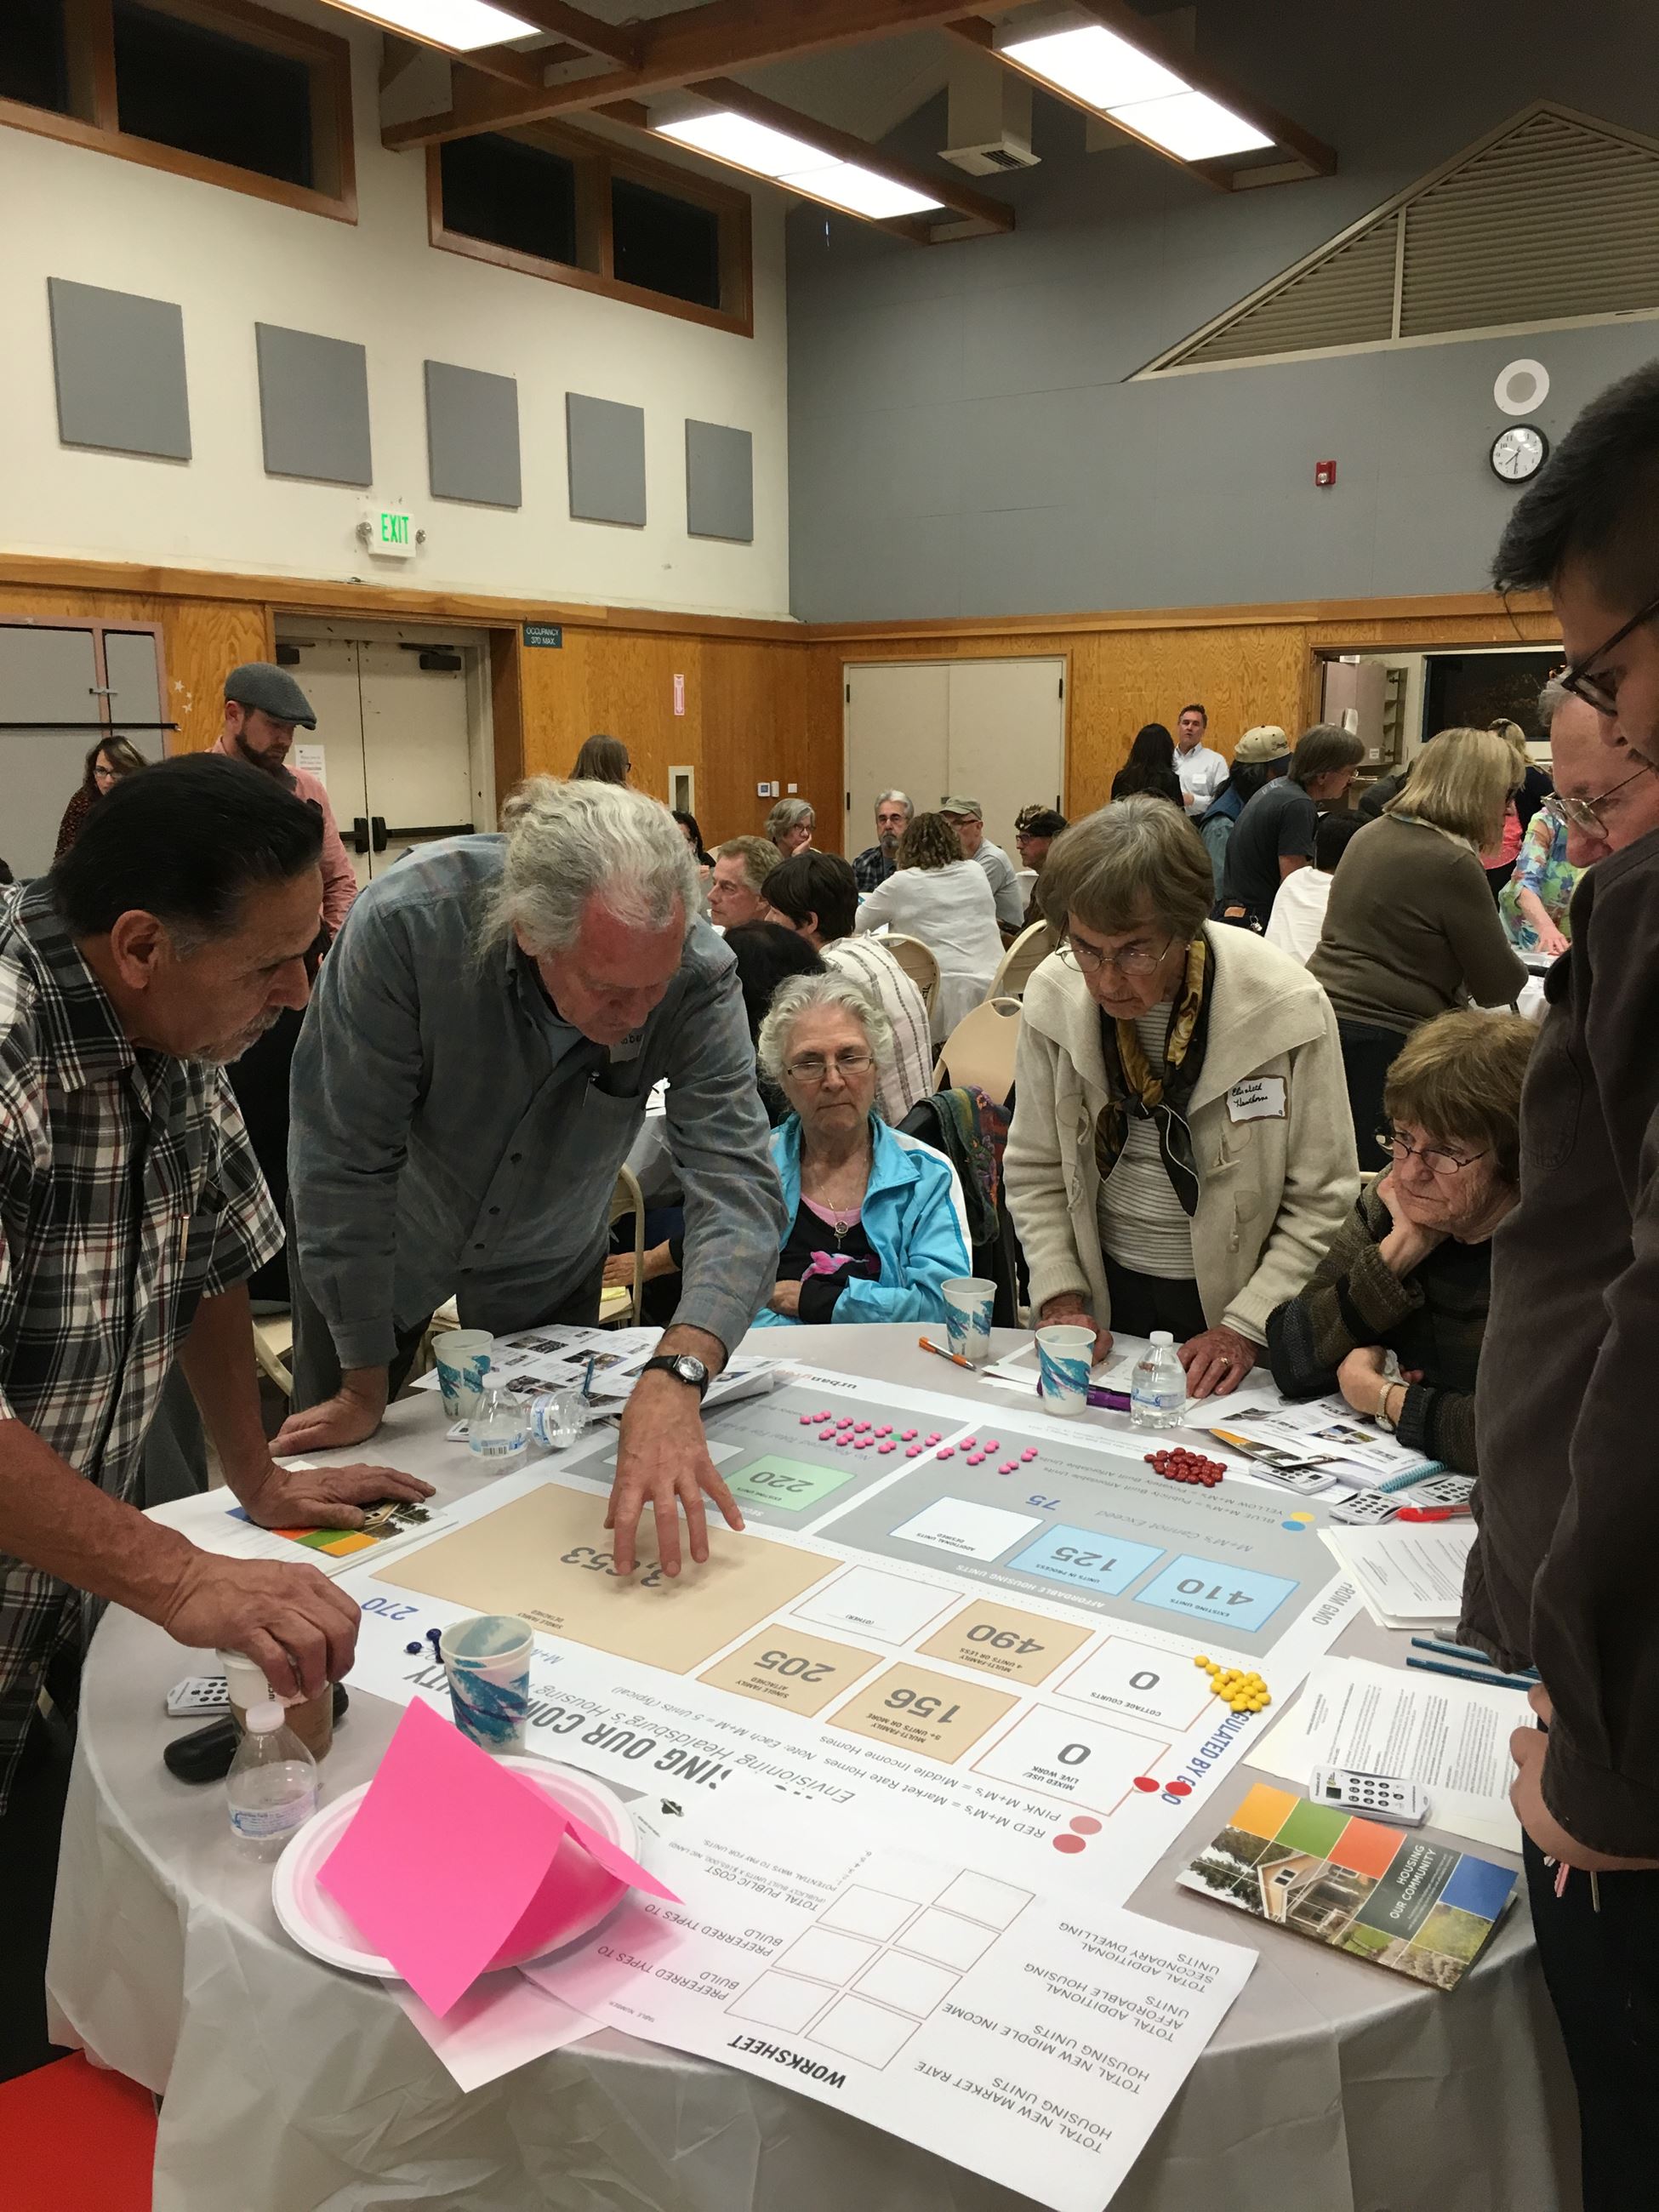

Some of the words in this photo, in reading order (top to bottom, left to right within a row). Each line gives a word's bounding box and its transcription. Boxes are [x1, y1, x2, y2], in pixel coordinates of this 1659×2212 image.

[381, 513, 408, 544] EXIT
[526, 626, 559, 636] OCCUPANCY
[530, 636, 541, 645] 370
[749, 1471, 814, 1493] 220
[1025, 1495, 1061, 1511] 75
[1095, 1510, 1146, 1526] Exceed
[1246, 1512, 1275, 1525] BLUE
[916, 1532, 936, 1542] UNITS
[937, 1533, 964, 1544] DESIRED
[1149, 1522, 1200, 1539] Cannot
[938, 1536, 976, 1552] ADDITIONAL
[1204, 1535, 1253, 1553] M+M's
[561, 1547, 662, 1588] 3,53
[1051, 1547, 1118, 1571] 125
[955, 1565, 988, 1576] UNITS
[1036, 1564, 1067, 1576] PROCESS
[1078, 1574, 1100, 1584] UNITS
[989, 1573, 1036, 1592] HOUSING
[1177, 1578, 1255, 1606] 410
[1038, 1586, 1103, 1609] AFFORDABLE
[1170, 1599, 1194, 1609] UNITS
[361, 1598, 419, 1622] 270
[845, 1614, 875, 1626] (OTHER)
[1194, 1604, 1230, 1617] EXISTING
[1312, 1604, 1340, 1626] GMO
[966, 1624, 1045, 1655] 490
[959, 1647, 978, 1656] LESS
[991, 1655, 1015, 1667] UNITS
[753, 1650, 836, 1683] 205
[959, 1655, 1012, 1673] MULTI-FAMILY
[735, 1679, 763, 1691] FAMILY
[750, 1676, 789, 1691] ATTACHED
[1129, 1671, 1160, 1690] 0
[536, 1685, 611, 1718] Housing
[610, 1686, 661, 1707] (Typical)
[762, 1685, 790, 1699] SINGLE
[1090, 1691, 1122, 1706] COURTS
[660, 1702, 694, 1718] Units
[884, 1689, 961, 1724] 156
[1124, 1701, 1161, 1717] COTTAGE
[714, 1719, 750, 1737] M+M
[865, 1713, 890, 1724] MORE
[610, 1712, 734, 1761] Healdsburg's
[749, 1731, 782, 1749] Each
[869, 1722, 926, 1744] MULTI-FAMILY
[904, 1724, 928, 1736] UNITS
[1200, 1708, 1256, 1760] GULATED
[581, 1723, 657, 1760] OUR
[818, 1735, 863, 1755] Homes
[784, 1744, 818, 1761] Note:
[864, 1750, 911, 1772] Income
[1058, 1744, 1092, 1765] 0
[733, 1753, 857, 1804] Envisioning
[822, 1757, 867, 1779] Homes
[913, 1766, 960, 1788] Middle
[1022, 1770, 1045, 1782] USE/
[1031, 1765, 1058, 1777] WORK
[1185, 1757, 1211, 1779] BY
[868, 1773, 901, 1790] Rate
[1046, 1777, 1075, 1792] MIXED
[1060, 1773, 1080, 1785] LIVE
[901, 1783, 949, 1806] Market
[974, 1787, 1021, 1809] M+M's
[1160, 1775, 1196, 1805] GO
[963, 1804, 1011, 1827] M+M's
[1022, 1803, 1062, 1822] PINK
[1012, 1821, 1046, 1839] RED
[728, 1850, 744, 1860] FOR
[743, 1854, 760, 1866] PAY
[760, 1861, 771, 1869] TO
[1396, 1844, 1425, 1885] HOUSING
[704, 1864, 735, 1882] COST
[744, 1870, 767, 1884] UNITS
[772, 1864, 794, 1877] WAYS
[735, 1877, 783, 1899] PUBLIC
[767, 1878, 789, 1890] BUILT
[795, 1872, 838, 1892] POTENTIAL
[1389, 1901, 1407, 1919] OUR
[1401, 1848, 1437, 1901] COMMUNITY
[644, 1903, 662, 1916] TO
[785, 1893, 819, 1912] TOTAL
[661, 1910, 699, 1930] TYPES
[701, 1924, 774, 1958] PREFERRED
[743, 1928, 784, 1947] BUILD
[1057, 1920, 1128, 1954] DWELLING
[596, 1945, 615, 1958] TO
[1080, 1941, 1161, 1975] ADDITIONAL
[615, 1952, 653, 1974] TYPES
[1129, 1947, 1216, 1985] SECONDARY
[1176, 1952, 1220, 1975] UNITS
[654, 1968, 730, 2001] PREFERRED
[698, 1970, 741, 1991] BUILD
[1023, 1962, 1089, 1995] HOUSING
[1165, 1970, 1207, 1994] TOTAL
[608, 2002, 636, 2015] NUMBER
[1045, 1981, 1127, 2022] ADDITIONAL
[1092, 1987, 1185, 2031] AFFORDABLE
[1144, 1994, 1190, 2021] UNITS
[941, 2002, 999, 2031] INCOME
[1001, 2025, 1057, 2055] MIDDLE
[1032, 2024, 1078, 2050] UNITS
[1132, 2016, 1176, 2044] TOTAL
[727, 2034, 847, 2089] WORKSHEET
[1055, 2049, 1094, 2072] NEW
[1080, 2044, 1150, 2083] HOUSING
[913, 2060, 952, 2084] RATE
[1097, 2066, 1143, 2095] TOTAL
[952, 2077, 1016, 2112] MARKET
[990, 2076, 1038, 2105] UNITS
[1016, 2105, 1054, 2129] NEW
[1040, 2099, 1113, 2141] HOUSING
[1057, 2123, 1104, 2155] TOTAL
